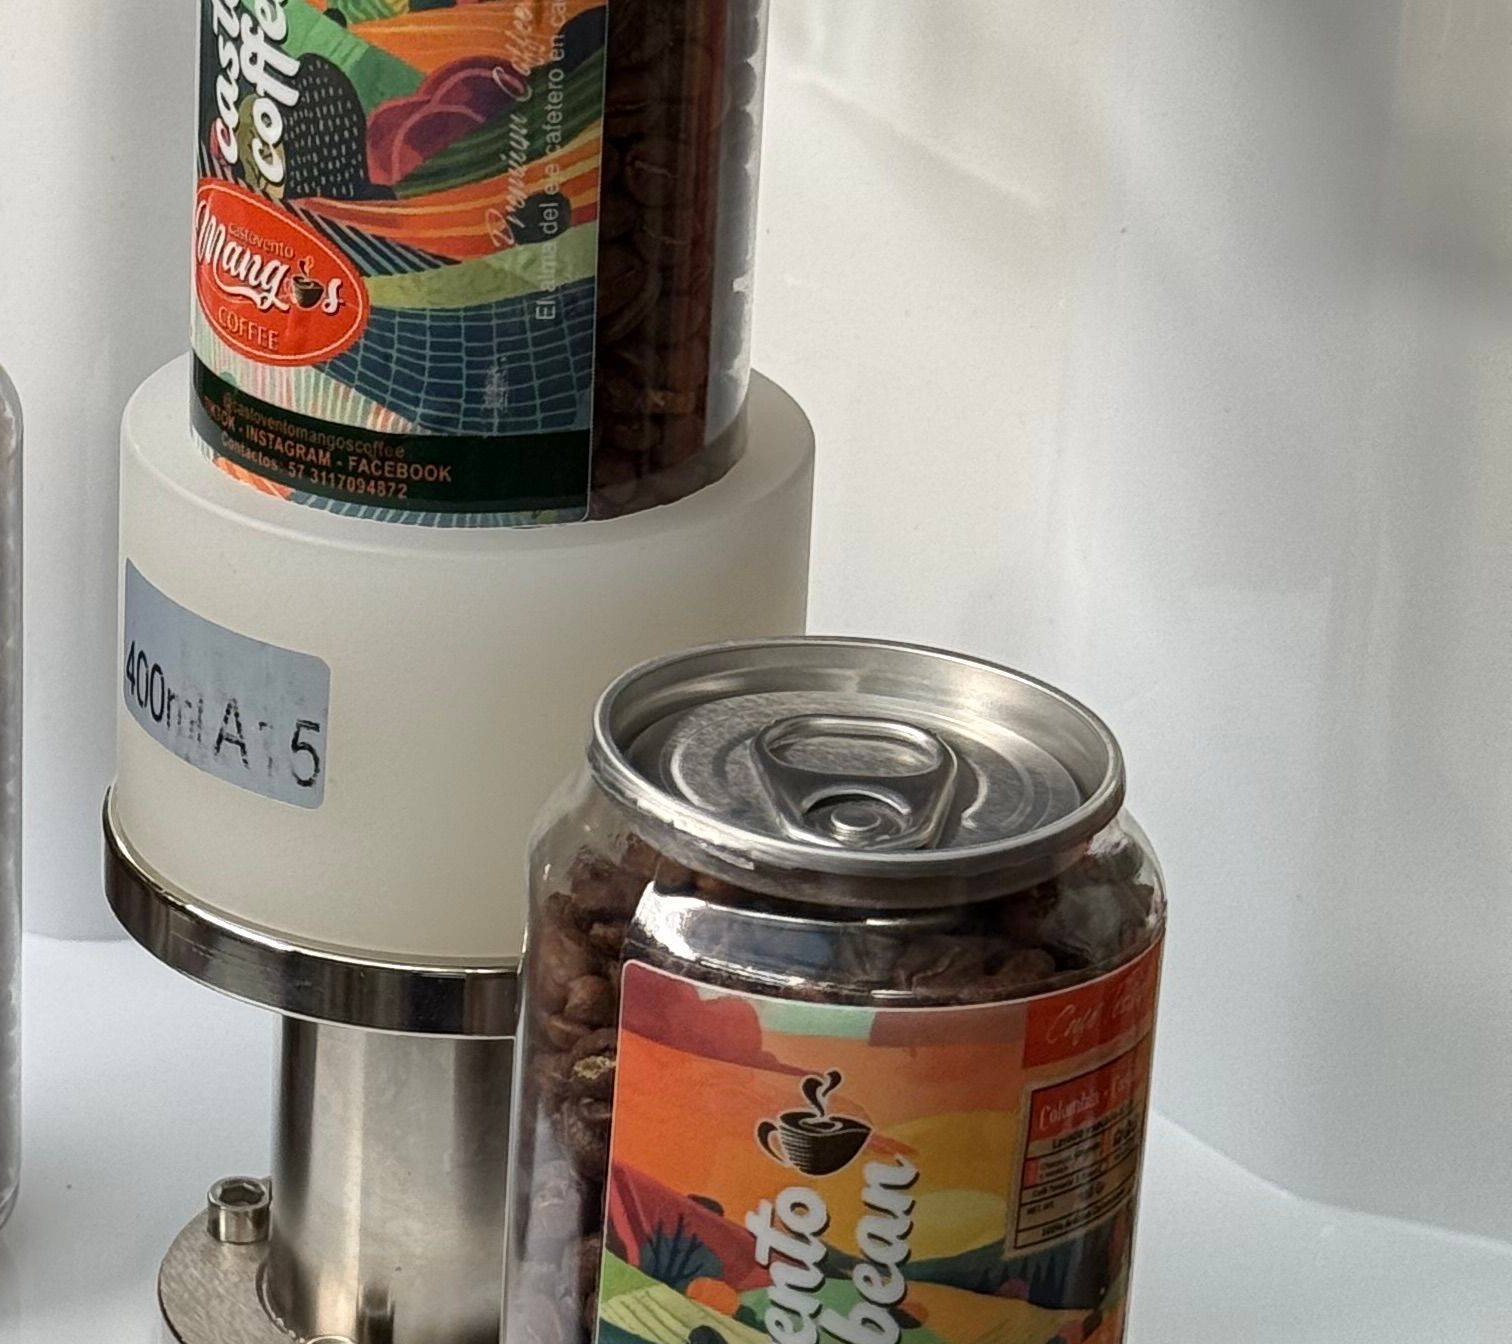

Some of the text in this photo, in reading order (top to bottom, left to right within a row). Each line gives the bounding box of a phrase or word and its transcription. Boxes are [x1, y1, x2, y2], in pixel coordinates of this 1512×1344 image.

[551, 32, 567, 61] en
[543, 67, 565, 156] cafetero
[538, 195, 559, 233] del
[535, 297, 556, 320] El
[218, 307, 279, 350] COFFEE
[245, 424, 332, 467] INSTAGRAM
[348, 456, 452, 483] FACEBOOK
[288, 462, 306, 478] 57
[310, 469, 408, 500] 3117094872
